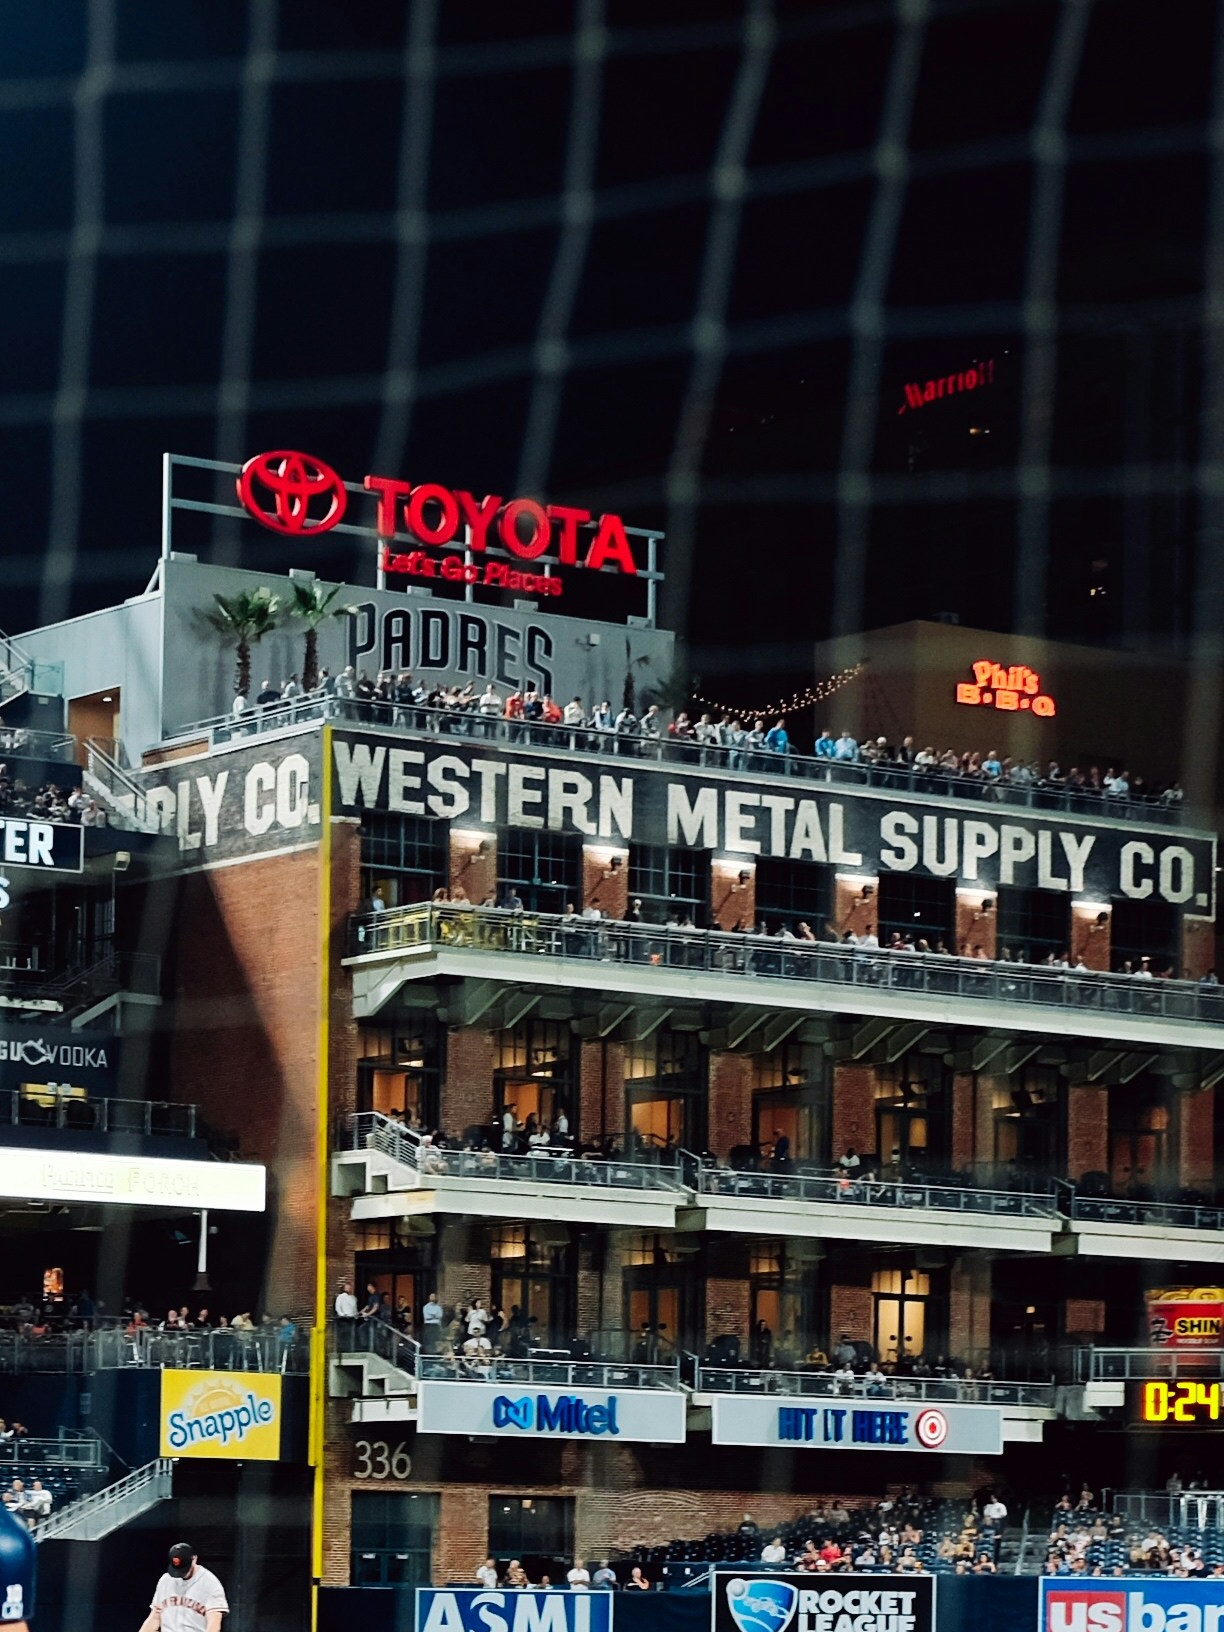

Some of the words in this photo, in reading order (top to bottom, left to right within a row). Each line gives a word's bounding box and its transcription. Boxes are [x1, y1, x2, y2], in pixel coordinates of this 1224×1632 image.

[364, 475, 636, 575] TOYOTA
[381, 546, 435, 578] Let's
[441, 556, 476, 584] Go
[483, 561, 563, 596] Places
[345, 602, 554, 697] PADRES
[971, 659, 1040, 694] Phil's
[244, 753, 320, 837] CO.
[332, 740, 633, 840] WESTERN
[667, 784, 862, 867] METAL
[880, 810, 1096, 892] SUPPLY
[1120, 841, 1208, 906] CO.
[46, 1044, 108, 1068] VODKA
[1178, 1319, 1221, 1334] SHIN
[169, 1393, 273, 1448] Snapple
[536, 1394, 619, 1435] Mitel
[1145, 1382, 1219, 1421] 0:24
[778, 1407, 817, 1441] HIT
[823, 1409, 847, 1442] IT
[851, 1410, 909, 1444] HERE
[354, 1440, 412, 1479] 336
[798, 1590, 916, 1614] ROCKET
